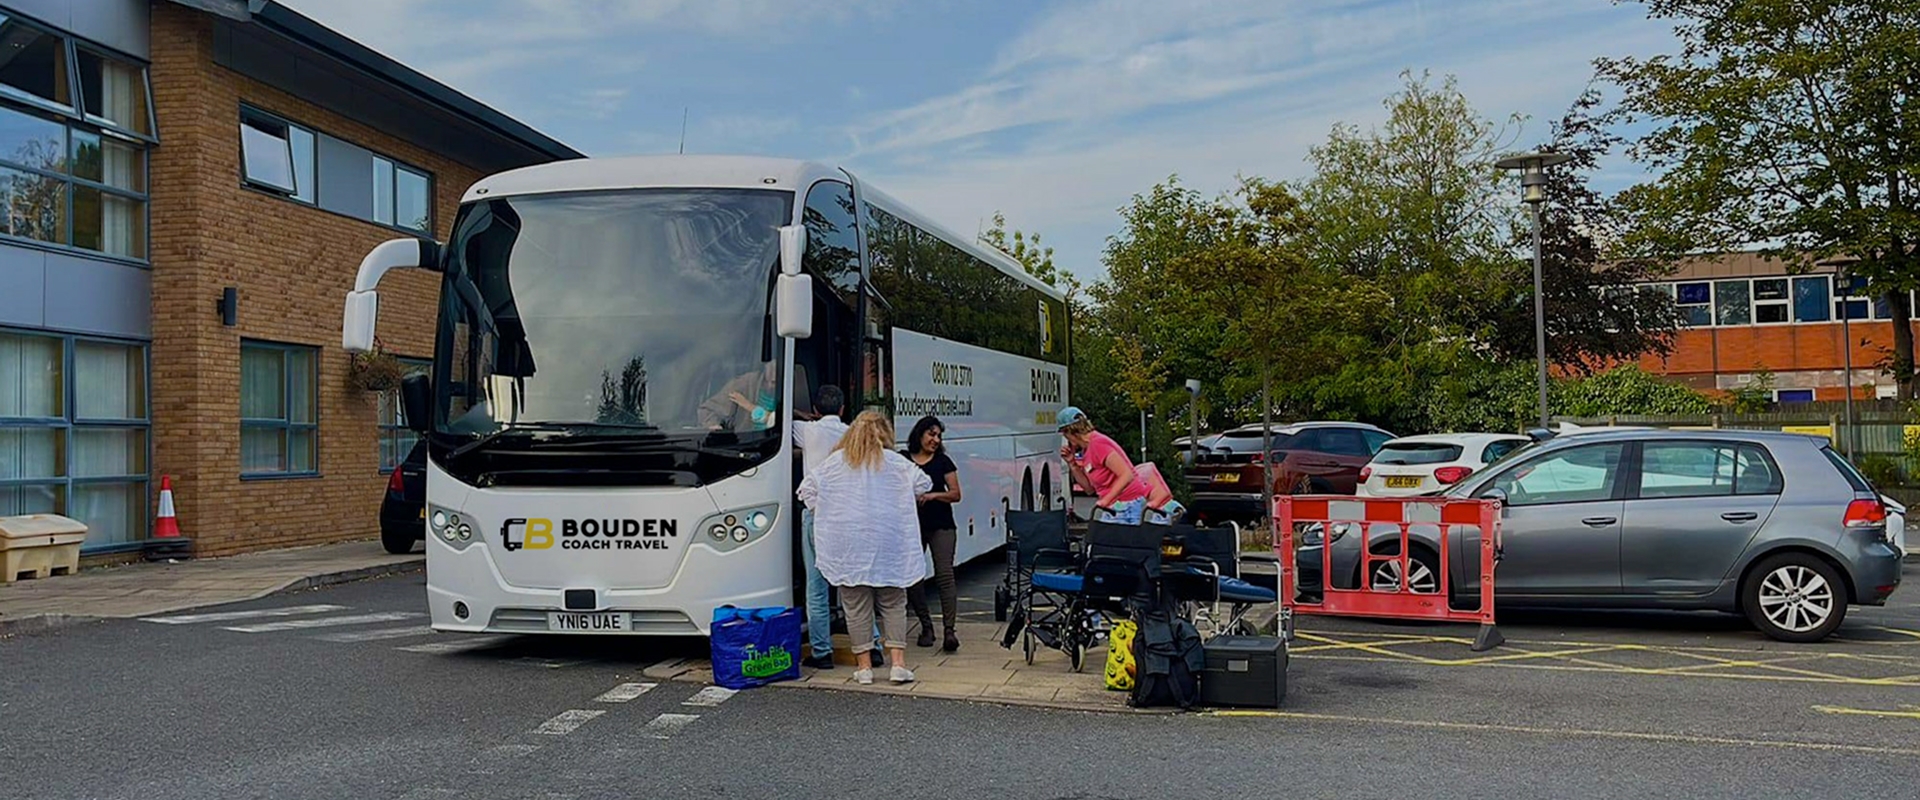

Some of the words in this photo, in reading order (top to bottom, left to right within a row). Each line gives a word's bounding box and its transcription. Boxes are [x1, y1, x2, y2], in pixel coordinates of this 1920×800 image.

[932, 361, 949, 385] 0800
[1031, 368, 1061, 403] BOUDEN
[562, 519, 677, 537] BOUDEN
[562, 540, 610, 550] COACH
[616, 540, 668, 550] TRAVEL
[557, 615, 589, 629] YN16
[592, 615, 621, 629] UAE
[746, 649, 768, 661] The
[745, 662, 772, 673] Green
[773, 658, 789, 668] Bag
